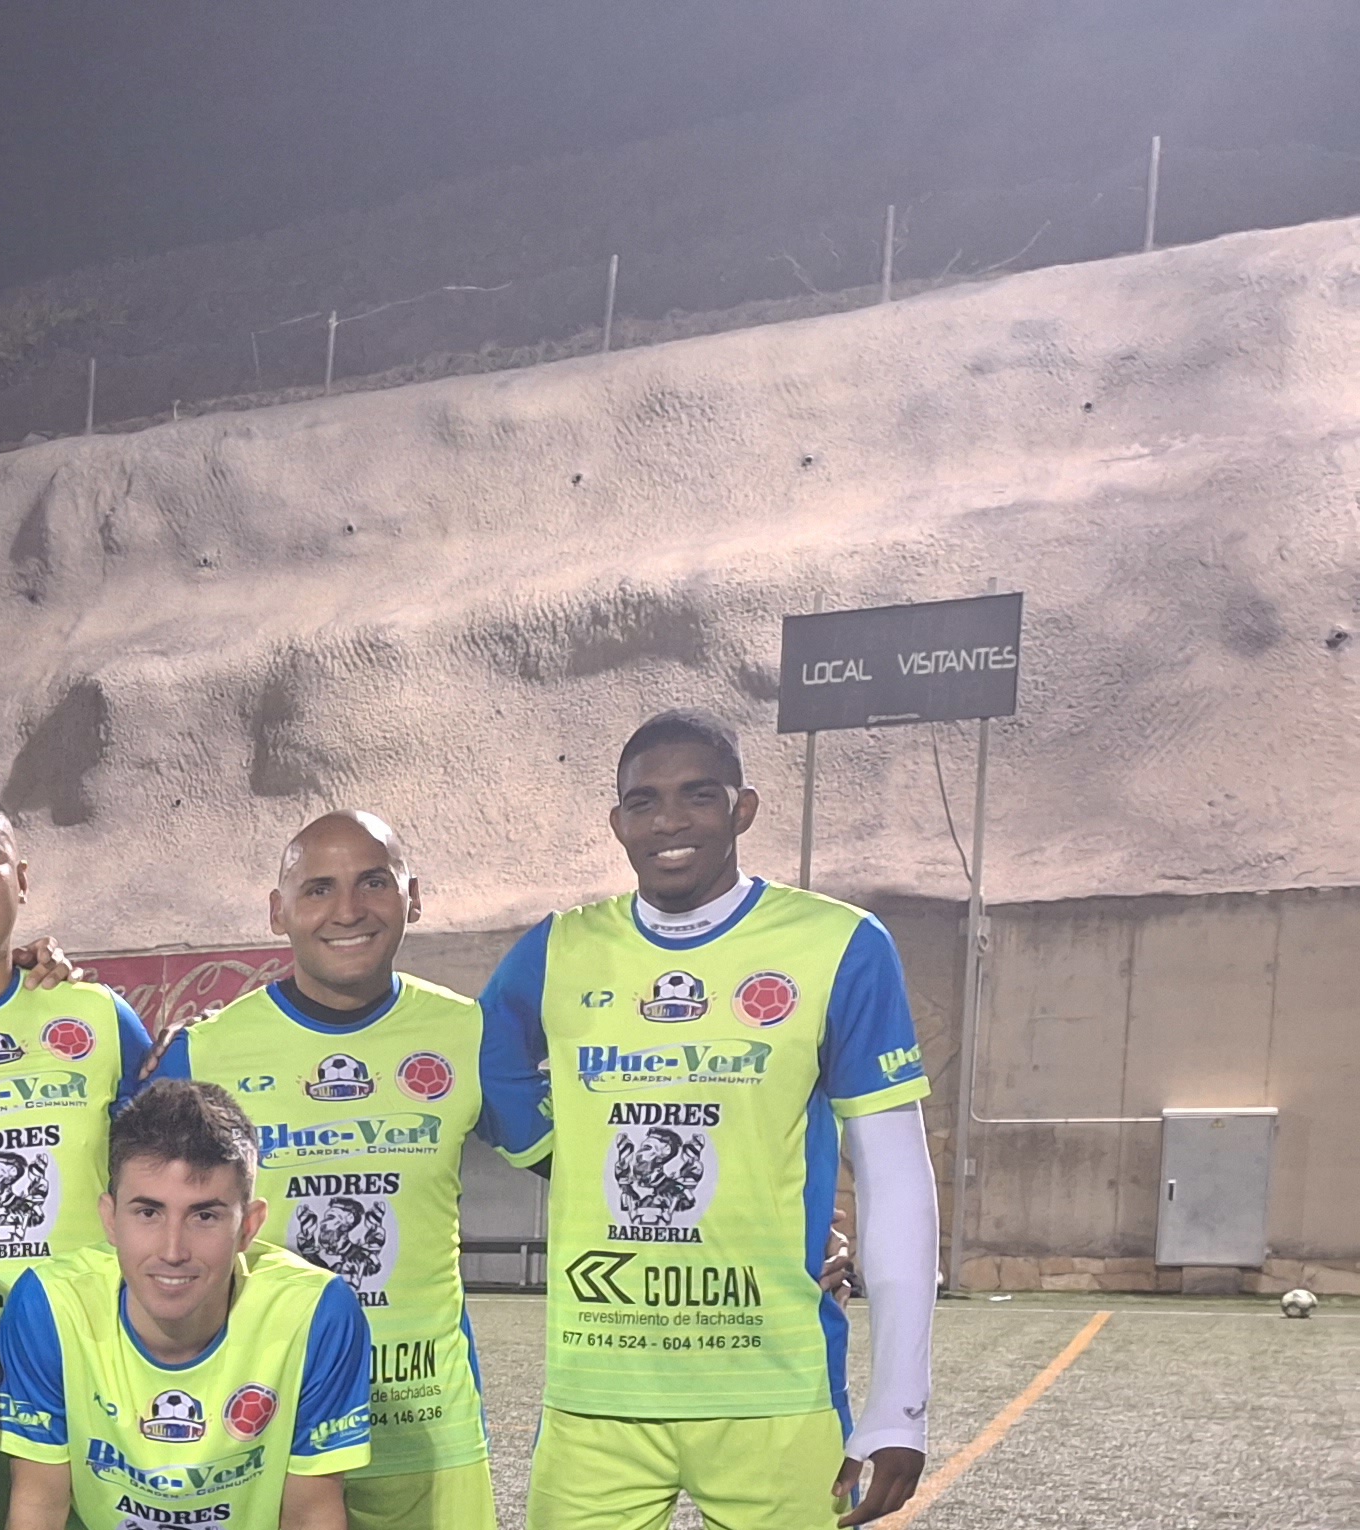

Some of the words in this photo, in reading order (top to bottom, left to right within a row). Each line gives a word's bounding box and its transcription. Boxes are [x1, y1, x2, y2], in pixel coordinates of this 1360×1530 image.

[802, 658, 873, 686] LOCAL
[897, 645, 1017, 676] VISITANTES
[577, 1040, 772, 1073] Blue-Vert
[608, 1103, 720, 1126] ANDRES
[255, 1113, 442, 1149] Blue-Vert
[286, 1173, 400, 1198] ANDRES
[607, 1225, 703, 1243] BARBERIA
[644, 1266, 761, 1307] COLCAN
[579, 1311, 669, 1326] revestimiento
[673, 1313, 690, 1325] de
[696, 1312, 763, 1326] fachadas
[563, 1331, 582, 1345] 677
[587, 1333, 613, 1346] 614
[619, 1334, 646, 1348] 524
[662, 1337, 692, 1350] 604
[698, 1336, 726, 1349] 146
[731, 1335, 761, 1348] 236
[370, 1339, 436, 1384] OLCAN
[372, 1388, 387, 1403] de
[391, 1382, 442, 1401] fachadas
[369, 1412, 387, 1426] 04
[393, 1409, 414, 1424] 146
[419, 1406, 442, 1421] 236
[87, 1438, 265, 1490] Blue-Vert
[116, 1495, 230, 1525] ANDRES
